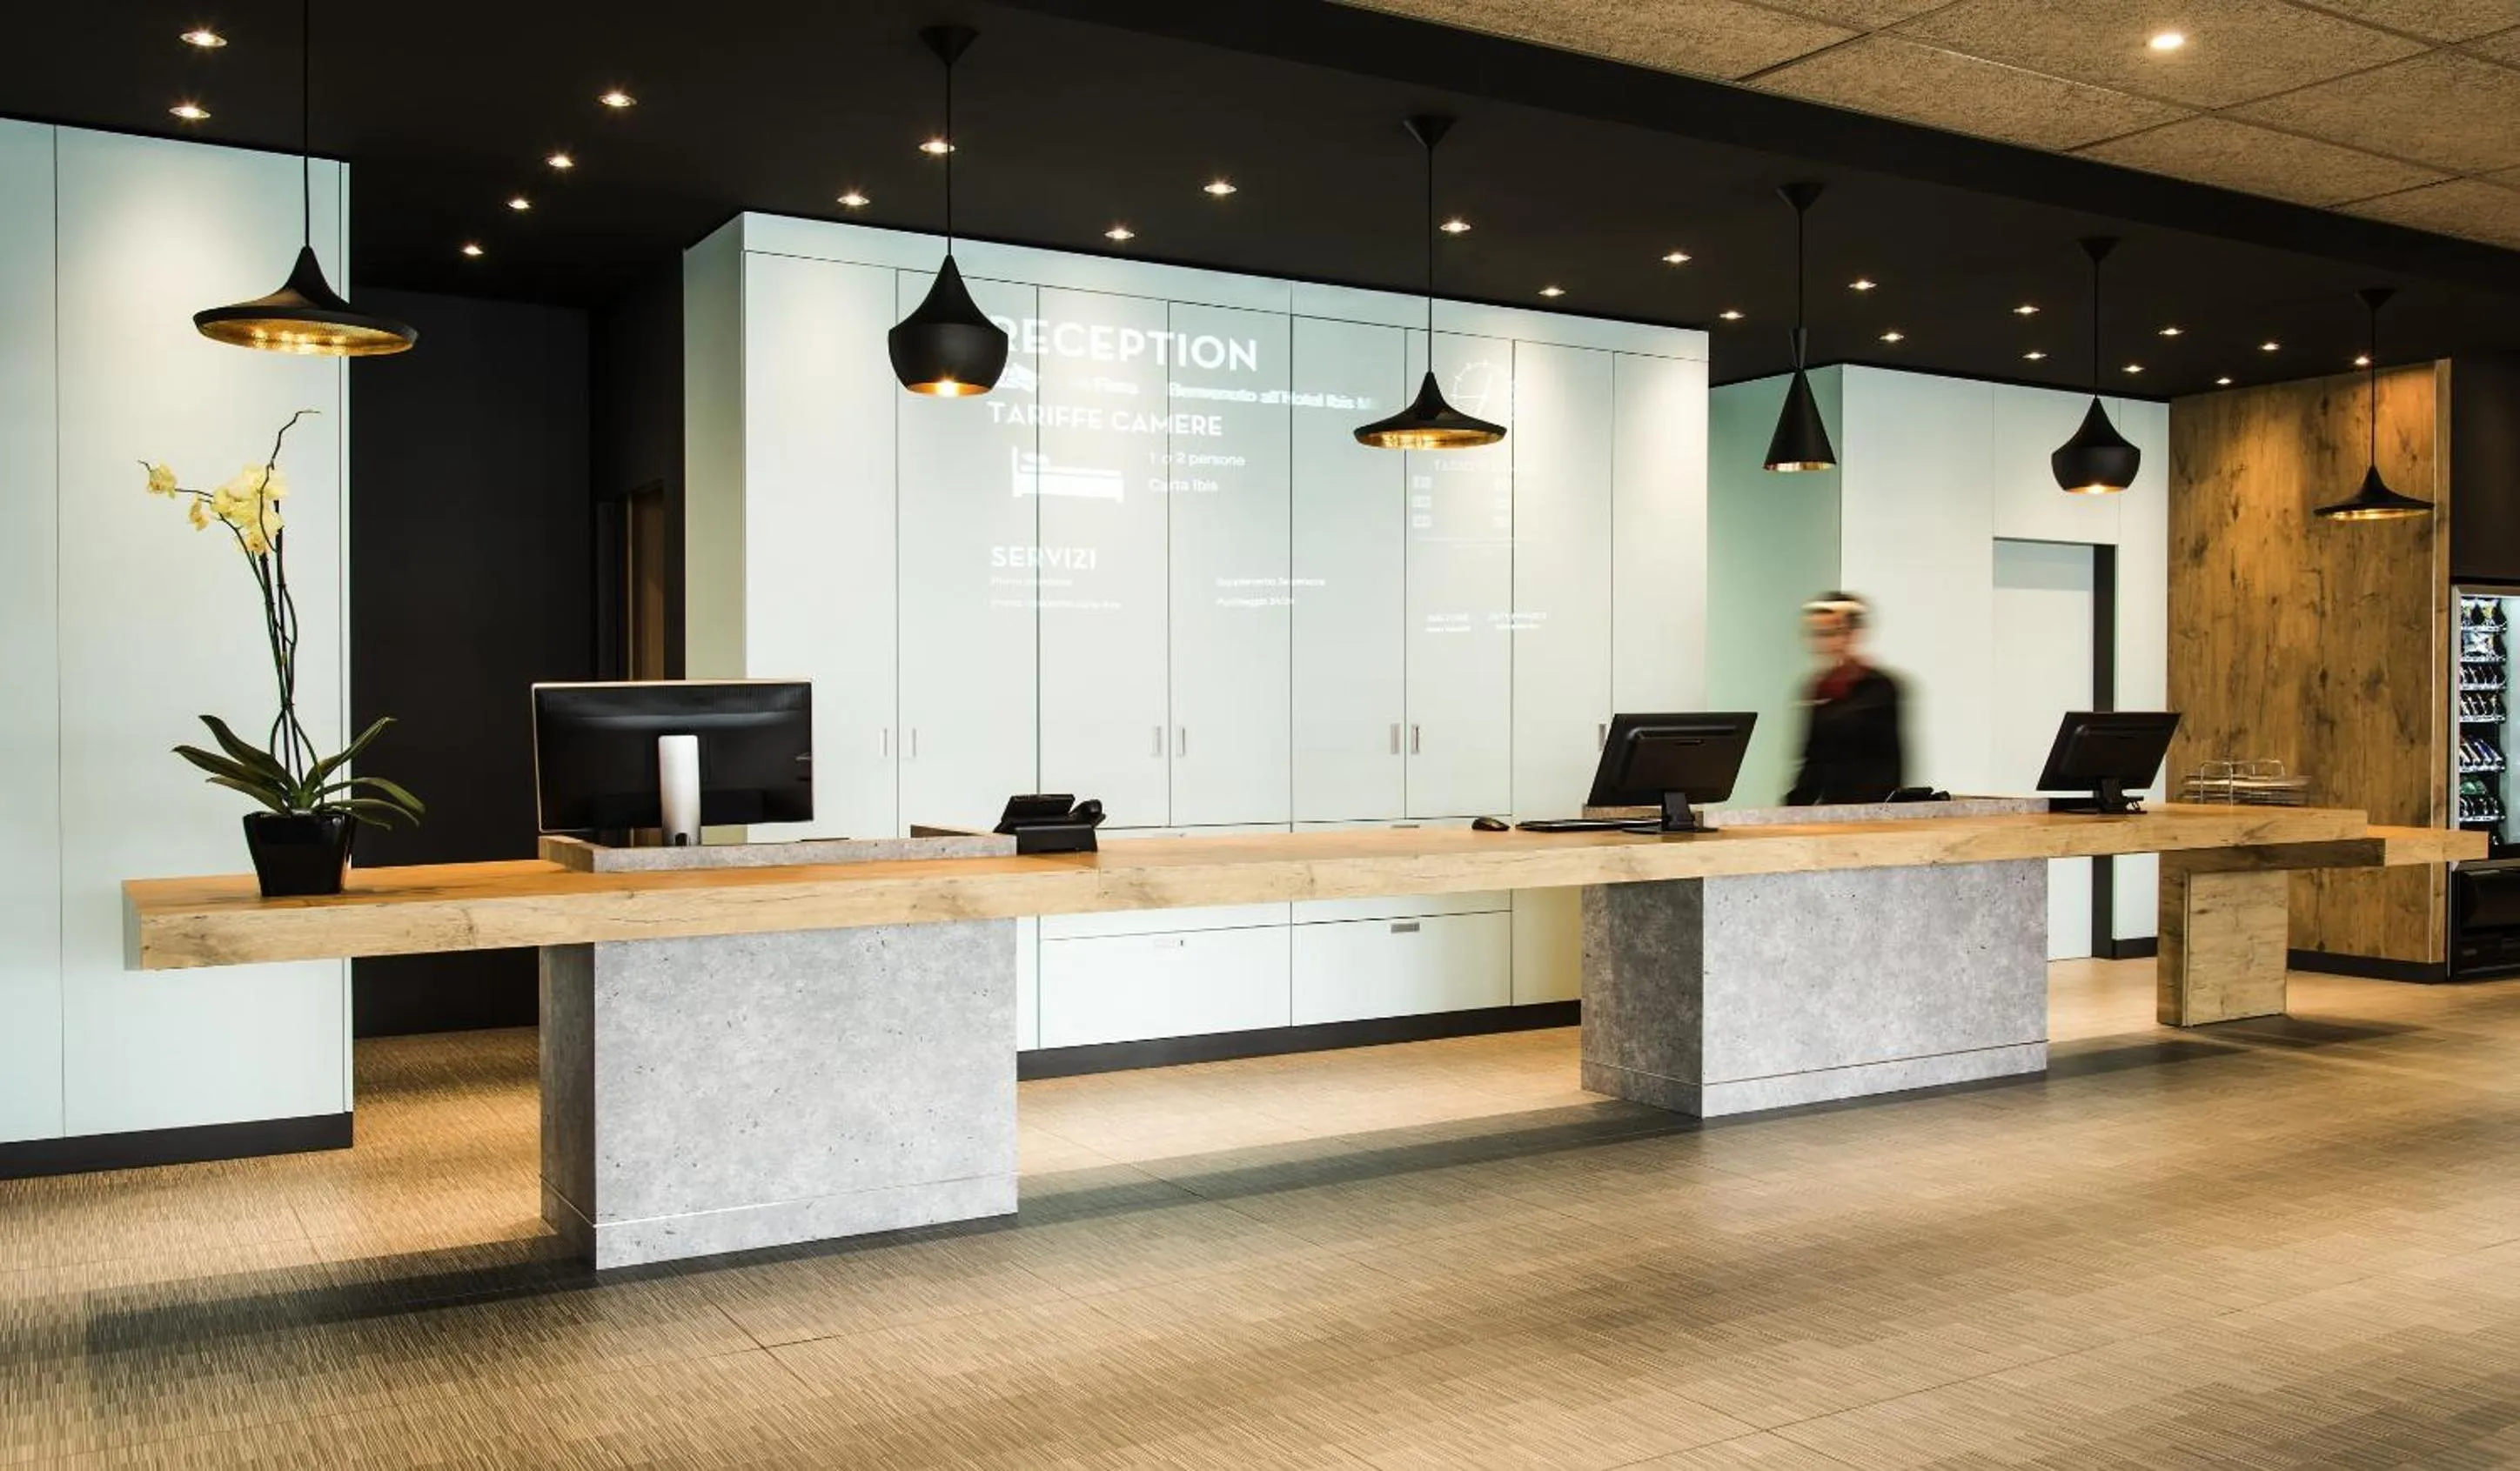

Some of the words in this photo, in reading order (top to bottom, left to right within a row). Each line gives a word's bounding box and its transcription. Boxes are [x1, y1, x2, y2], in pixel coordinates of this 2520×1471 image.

[989, 314, 1258, 372] RECEPTION
[986, 401, 1103, 431] TARIFFE
[1110, 410, 1223, 436] CAMERE
[990, 545, 1096, 571] SERVIZI
